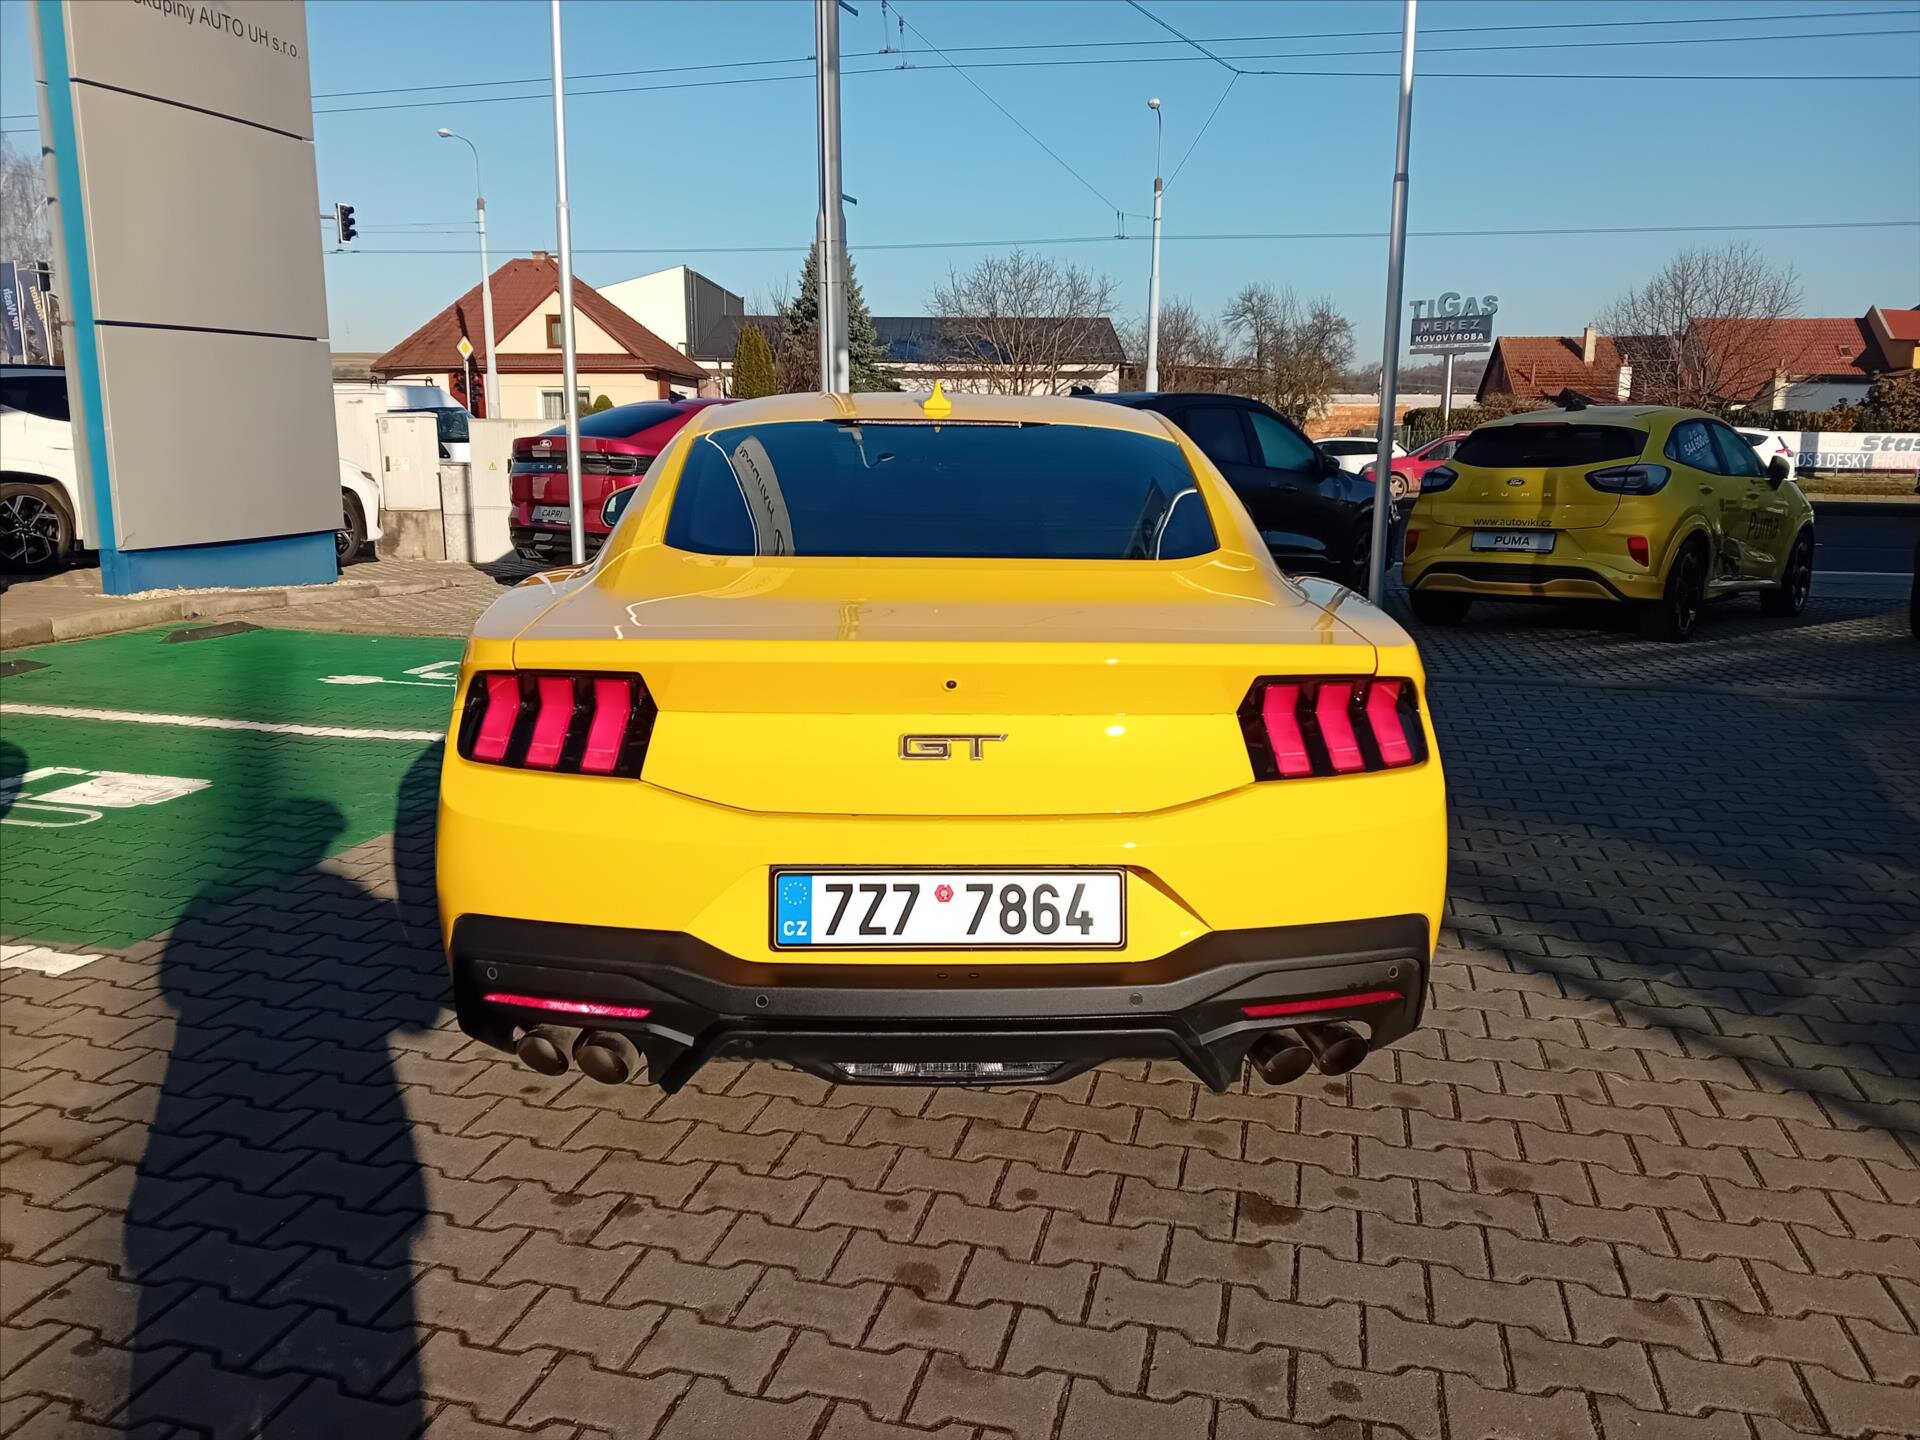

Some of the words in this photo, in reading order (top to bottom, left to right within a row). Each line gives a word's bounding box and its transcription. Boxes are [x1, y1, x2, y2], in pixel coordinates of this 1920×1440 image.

[133, 0, 195, 25] upiny
[199, 6, 244, 37] AUTO
[248, 23, 269, 47] UH
[272, 37, 301, 59] s.r.o.
[1409, 292, 1499, 318] TIGAS
[1420, 319, 1481, 333] NEREZ
[1415, 331, 1484, 342] KOVOVÝROBA
[1796, 453, 1822, 468] OSB
[1826, 453, 1871, 469] DESKY
[541, 509, 563, 518] CAPRI
[1473, 518, 1552, 528] www.autoviki.cz
[1494, 535, 1530, 546] PUMA
[898, 733, 1009, 760] GT
[825, 883, 921, 935] 7Z7
[965, 883, 1094, 935] 7864
[783, 920, 808, 936] CZ
